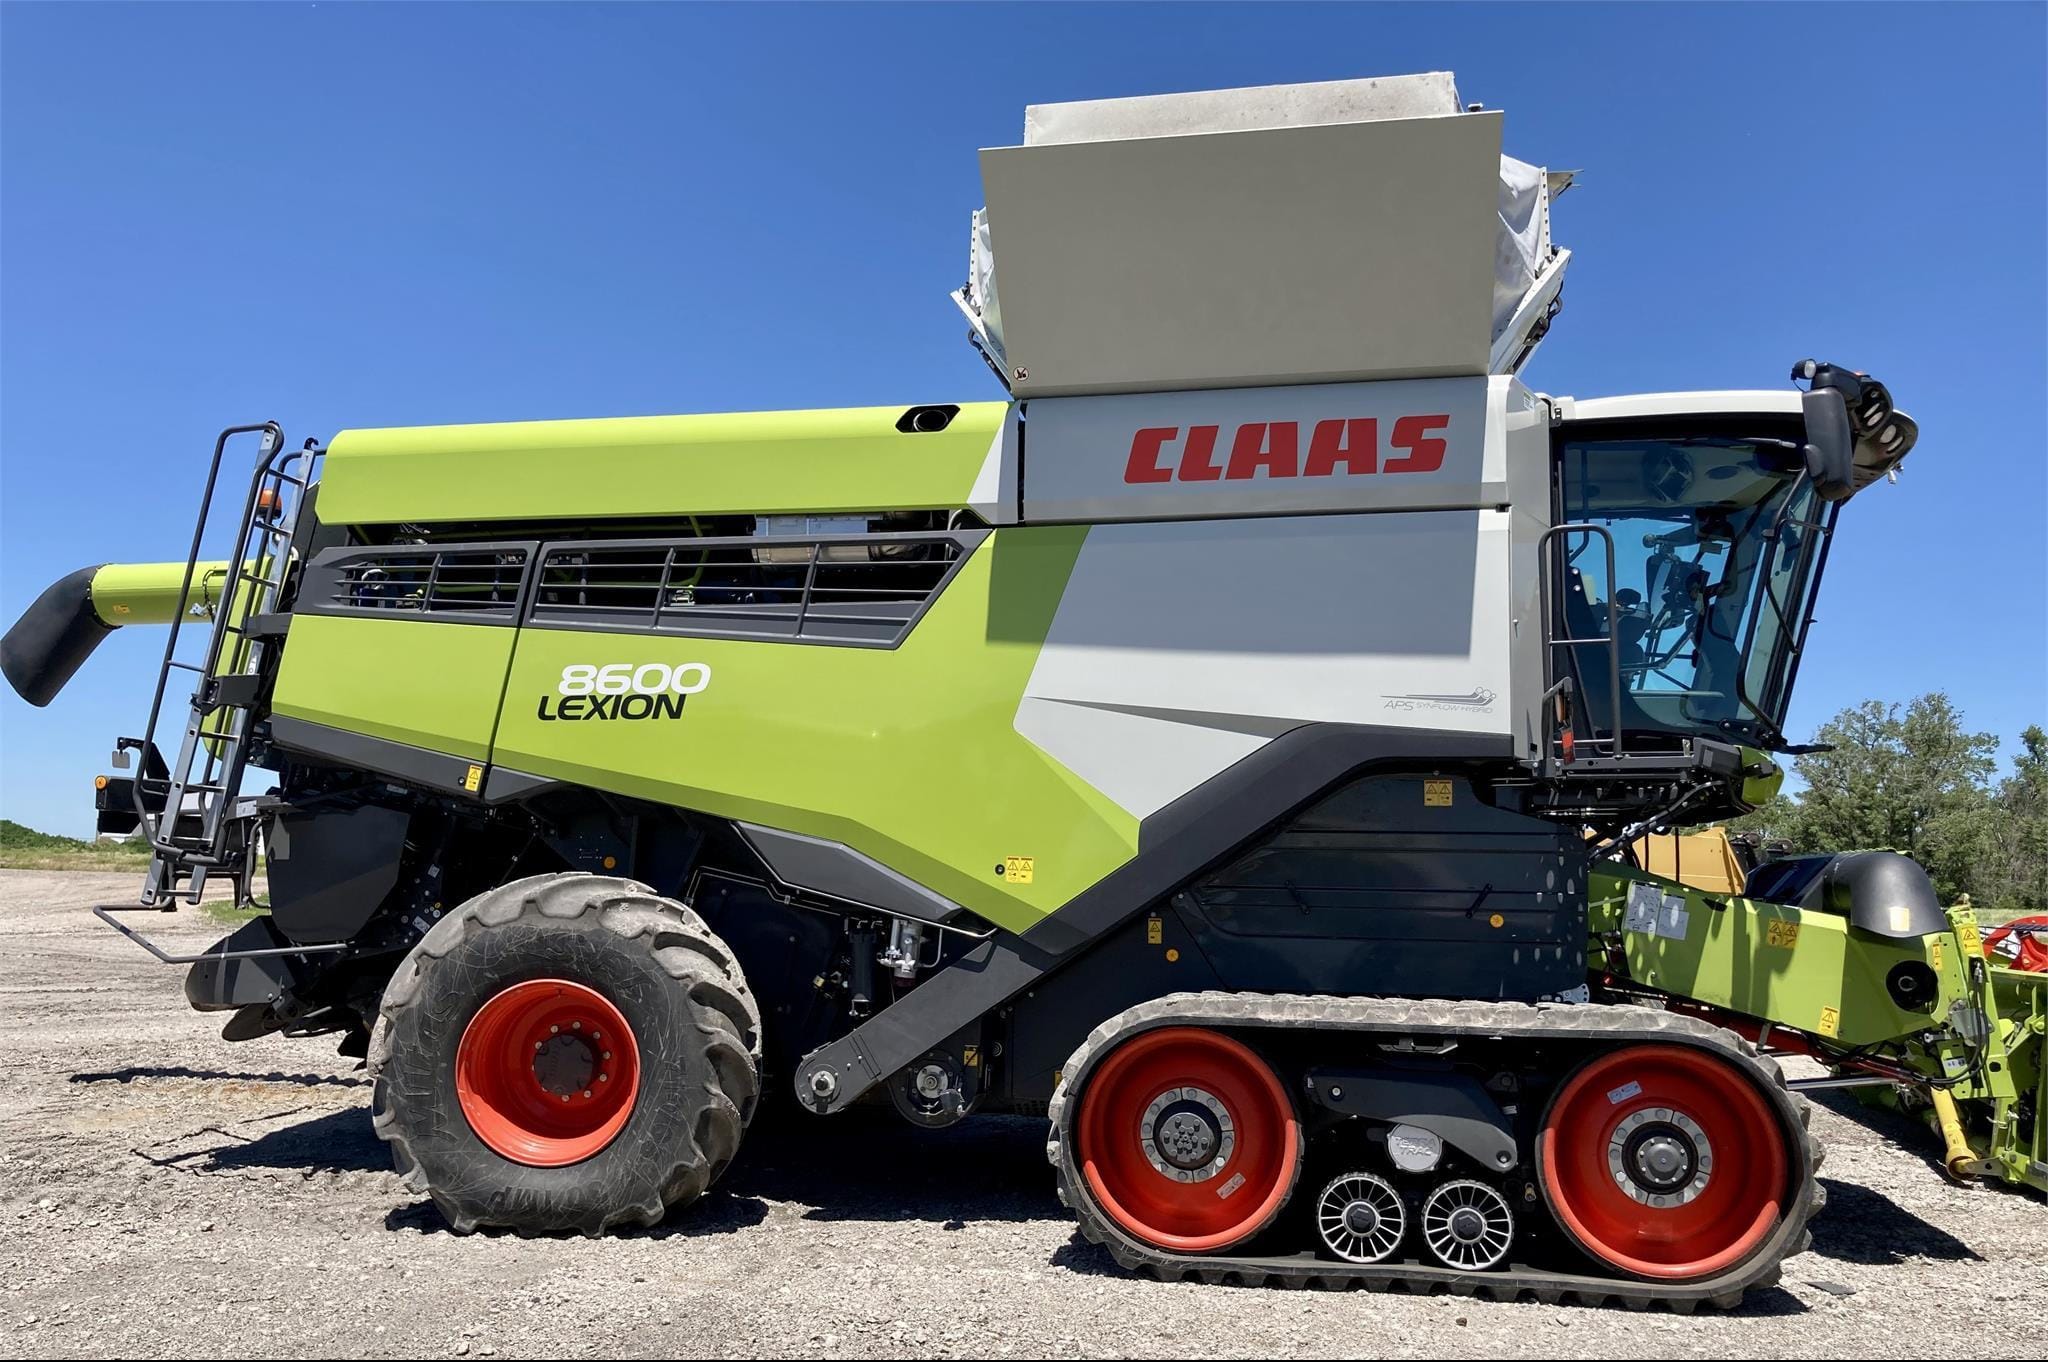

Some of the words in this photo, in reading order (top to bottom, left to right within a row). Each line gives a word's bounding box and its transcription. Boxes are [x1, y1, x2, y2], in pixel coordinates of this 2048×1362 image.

[1123, 414, 1450, 484] CLAAS
[558, 662, 712, 695] 8600
[538, 693, 687, 720] LEXION
[1383, 700, 1414, 711] APS
